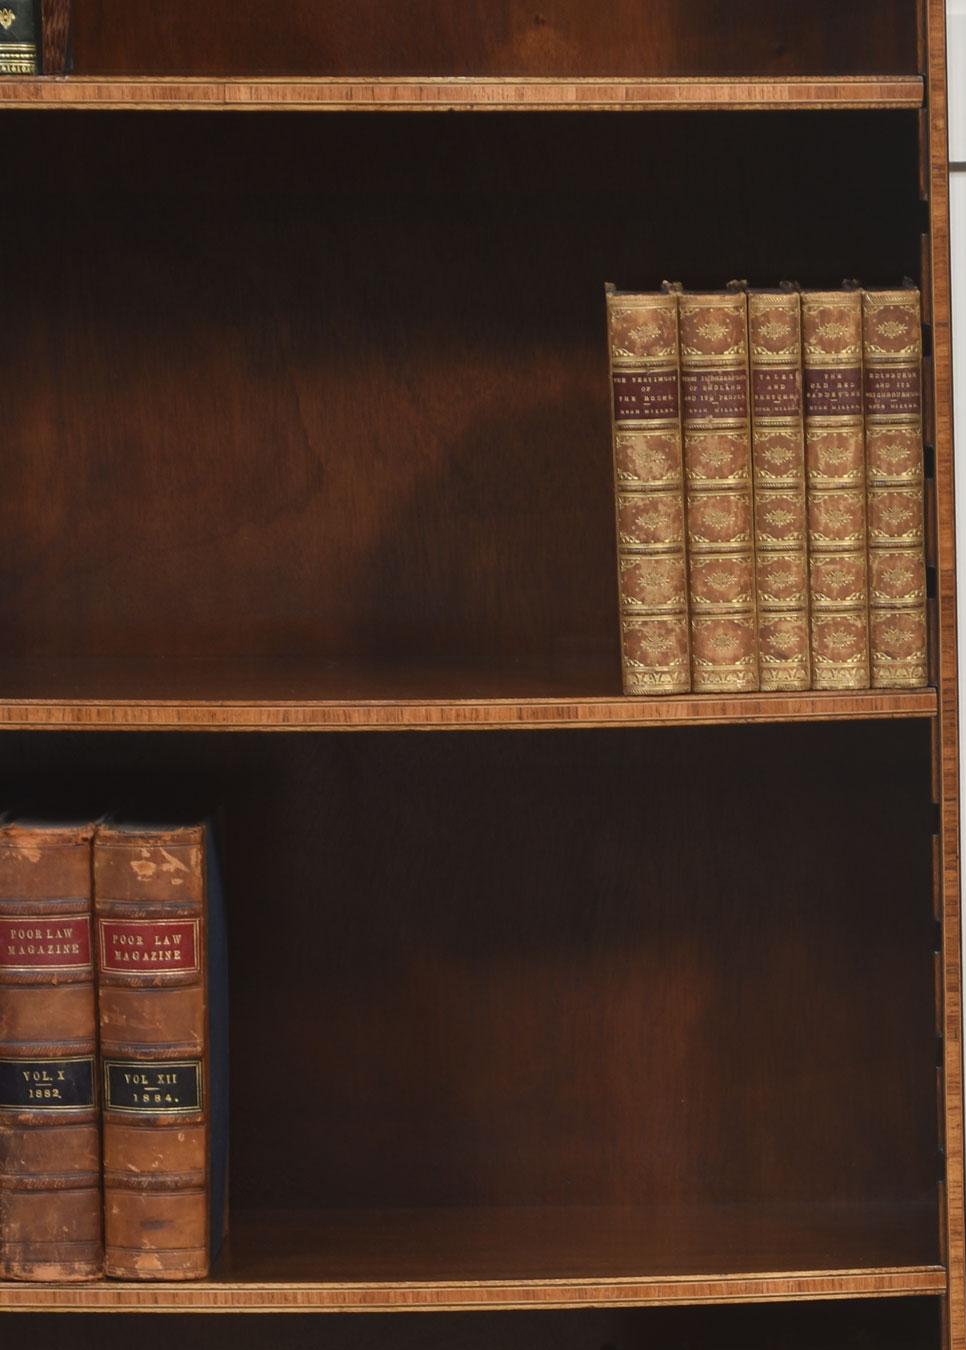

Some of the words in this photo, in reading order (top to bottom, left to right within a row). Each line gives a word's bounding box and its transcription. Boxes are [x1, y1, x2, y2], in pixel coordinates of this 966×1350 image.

[10, 929, 42, 939] POOR
[46, 929, 72, 939] LAW
[112, 934, 144, 945] POOR
[155, 934, 181, 945] LAW
[8, 944, 79, 955] MAGAZINE
[114, 950, 181, 961] MAGAZINE
[23, 1071, 53, 1081] VOL.
[57, 1071, 65, 1080] X
[124, 1074, 148, 1084] VOL
[157, 1074, 176, 1084] XII
